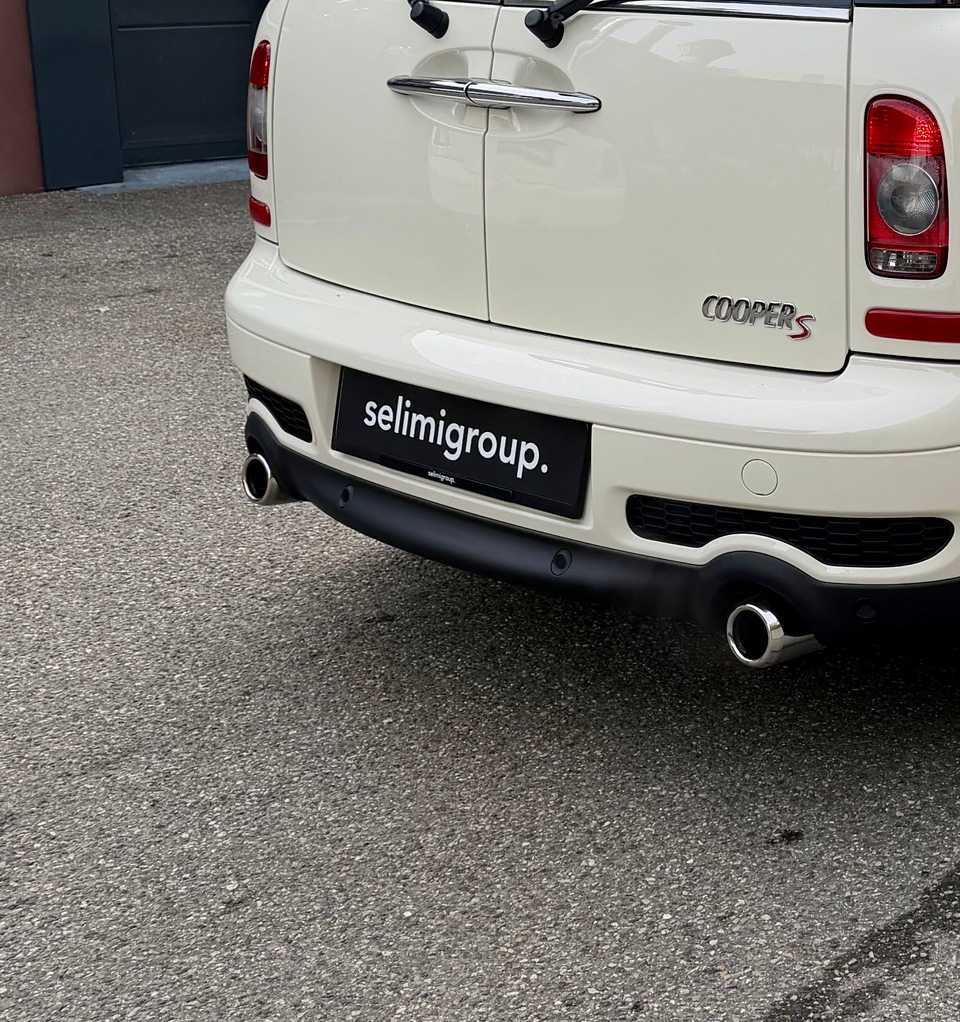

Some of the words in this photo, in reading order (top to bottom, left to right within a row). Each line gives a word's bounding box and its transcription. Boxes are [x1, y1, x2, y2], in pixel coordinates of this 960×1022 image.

[702, 294, 796, 329] COOPER
[786, 314, 815, 341] S
[363, 395, 548, 478] selimigroup.
